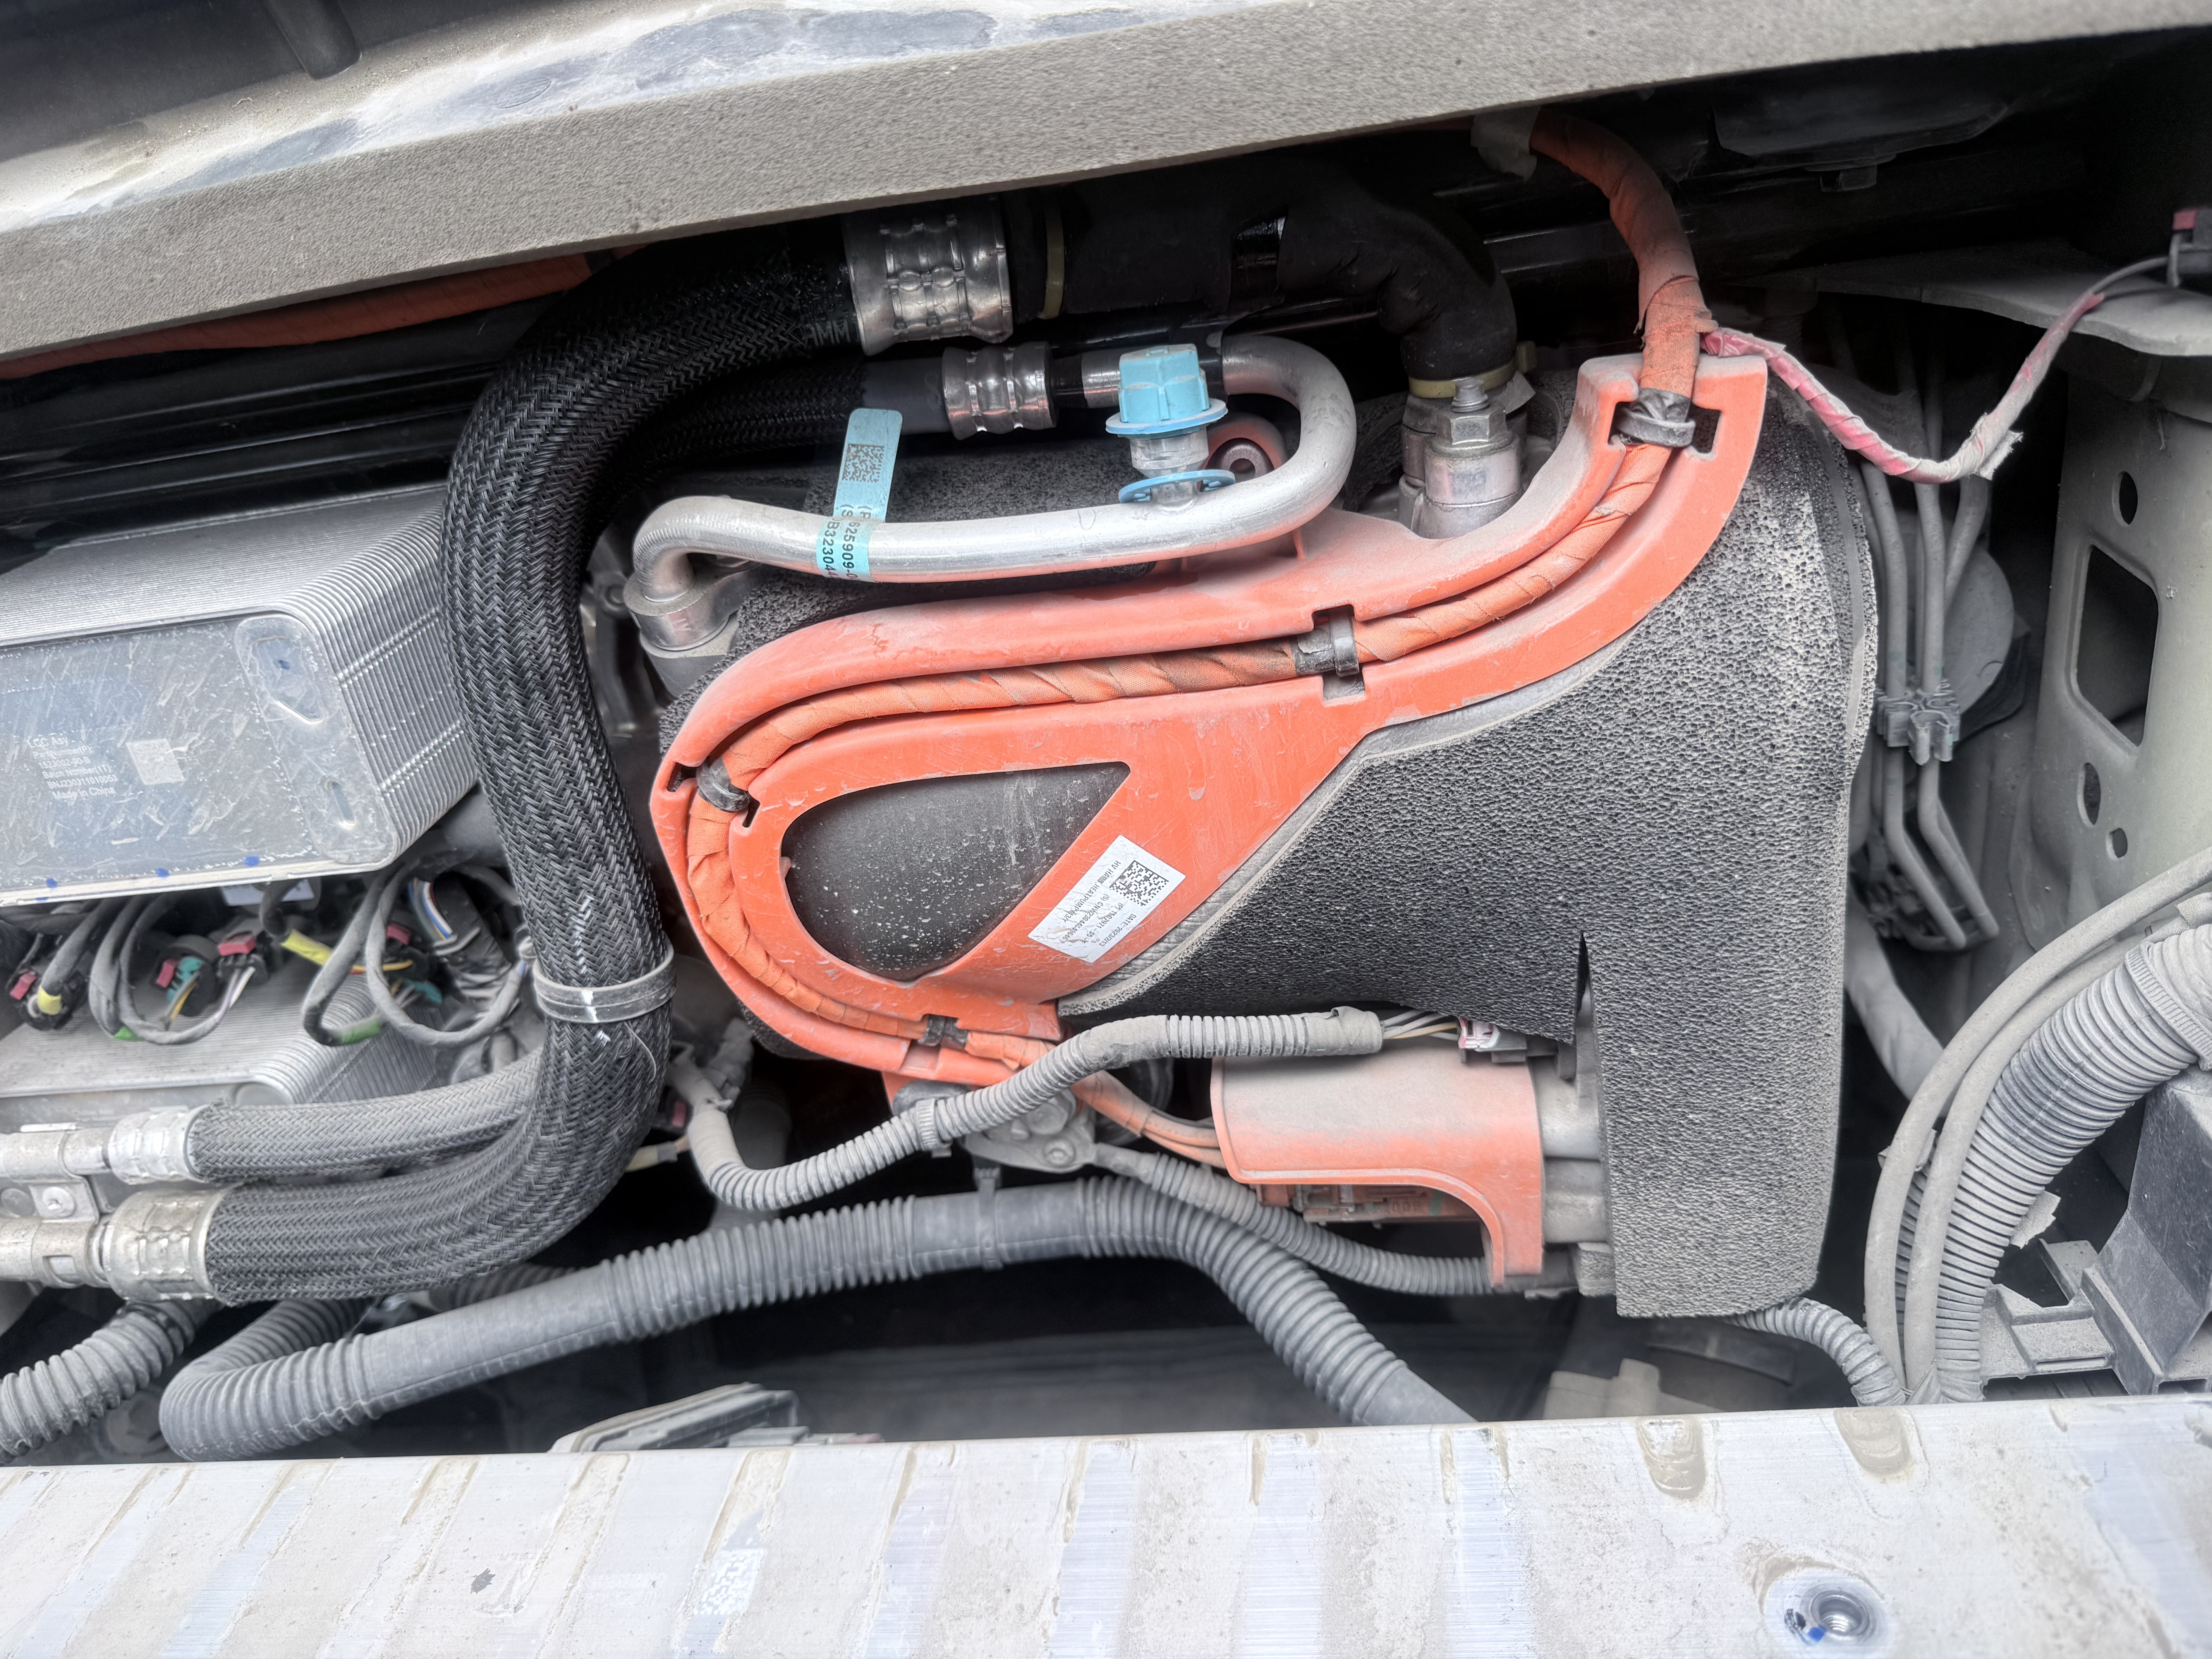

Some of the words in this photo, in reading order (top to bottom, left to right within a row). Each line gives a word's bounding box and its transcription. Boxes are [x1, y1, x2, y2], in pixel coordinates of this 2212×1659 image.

[27, 737, 49, 748] LCC
[52, 736, 69, 746] Asy
[42, 770, 65, 779] Batch
[52, 790, 78, 800] Made
[80, 789, 88, 797] in
[89, 786, 117, 797] China
[1112, 861, 1120, 869] HV
